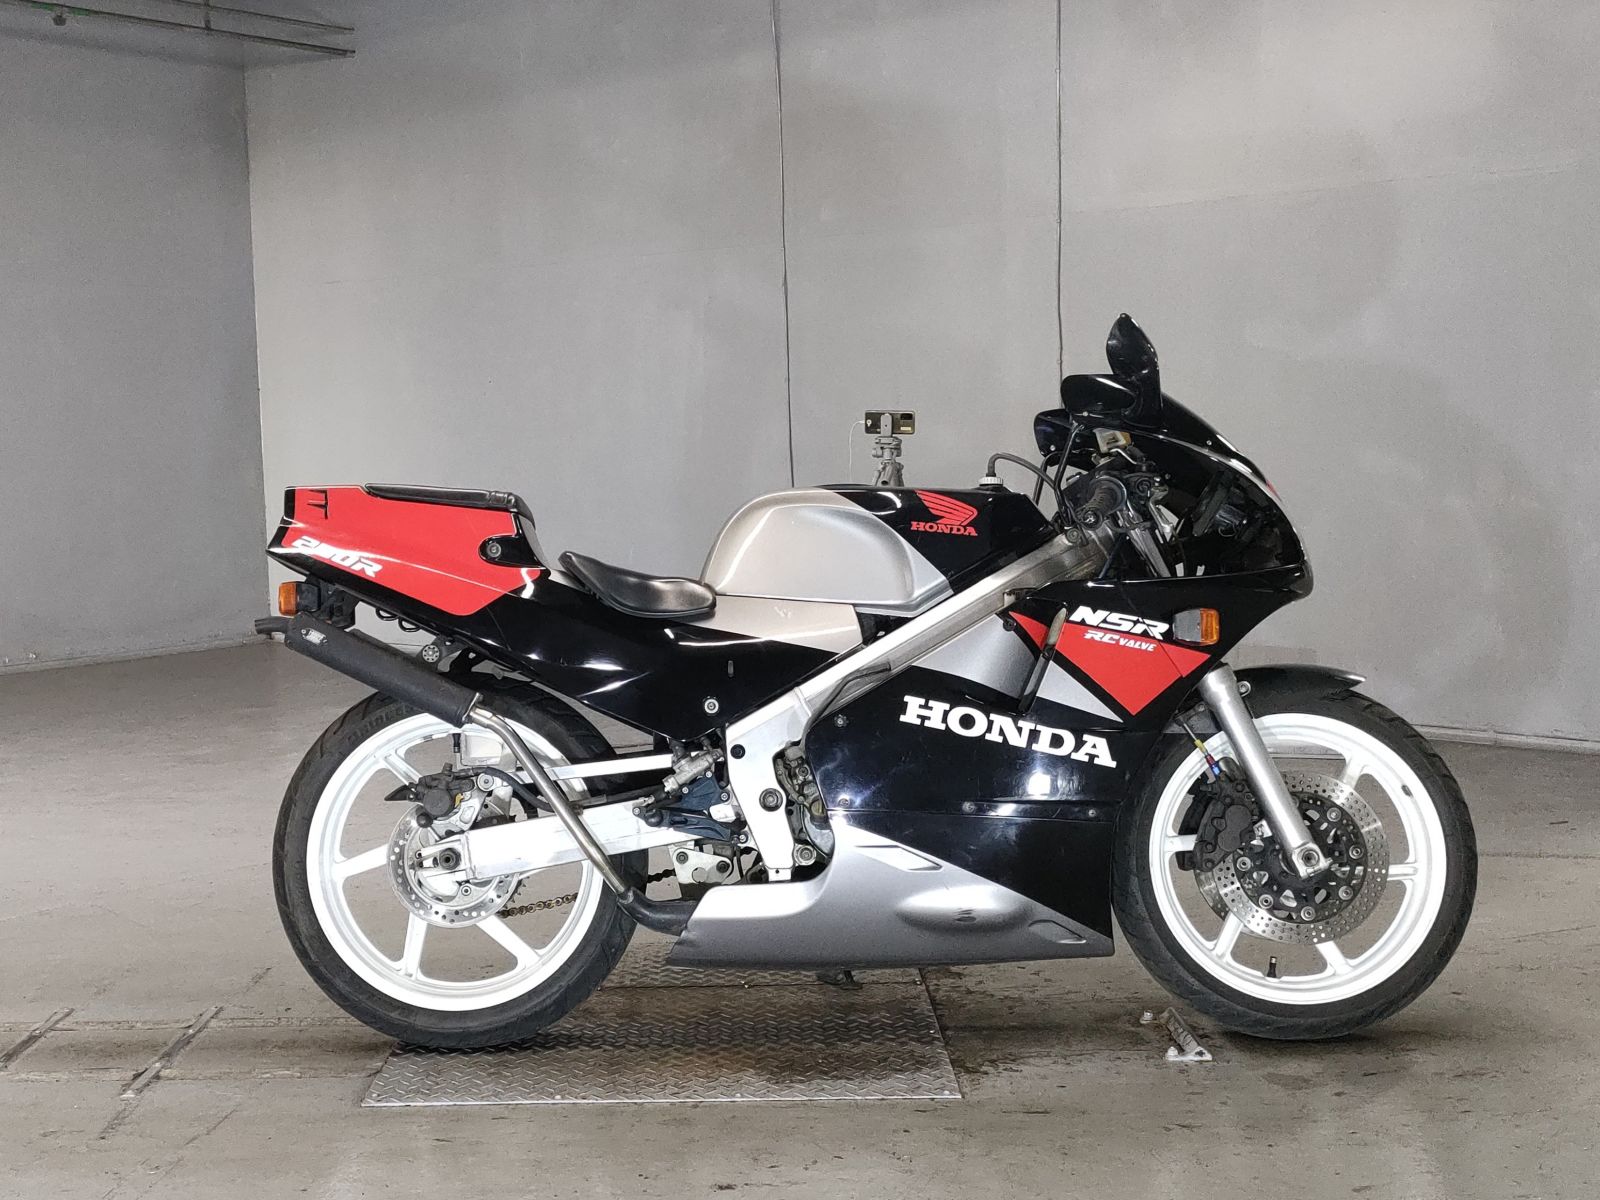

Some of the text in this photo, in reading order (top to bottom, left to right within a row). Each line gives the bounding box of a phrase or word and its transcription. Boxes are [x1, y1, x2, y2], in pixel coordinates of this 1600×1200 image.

[910, 521, 978, 536] HONDA
[1069, 605, 1170, 640] NSR
[1084, 629, 1157, 652] RC VALVE
[899, 695, 1117, 769] HONDA
